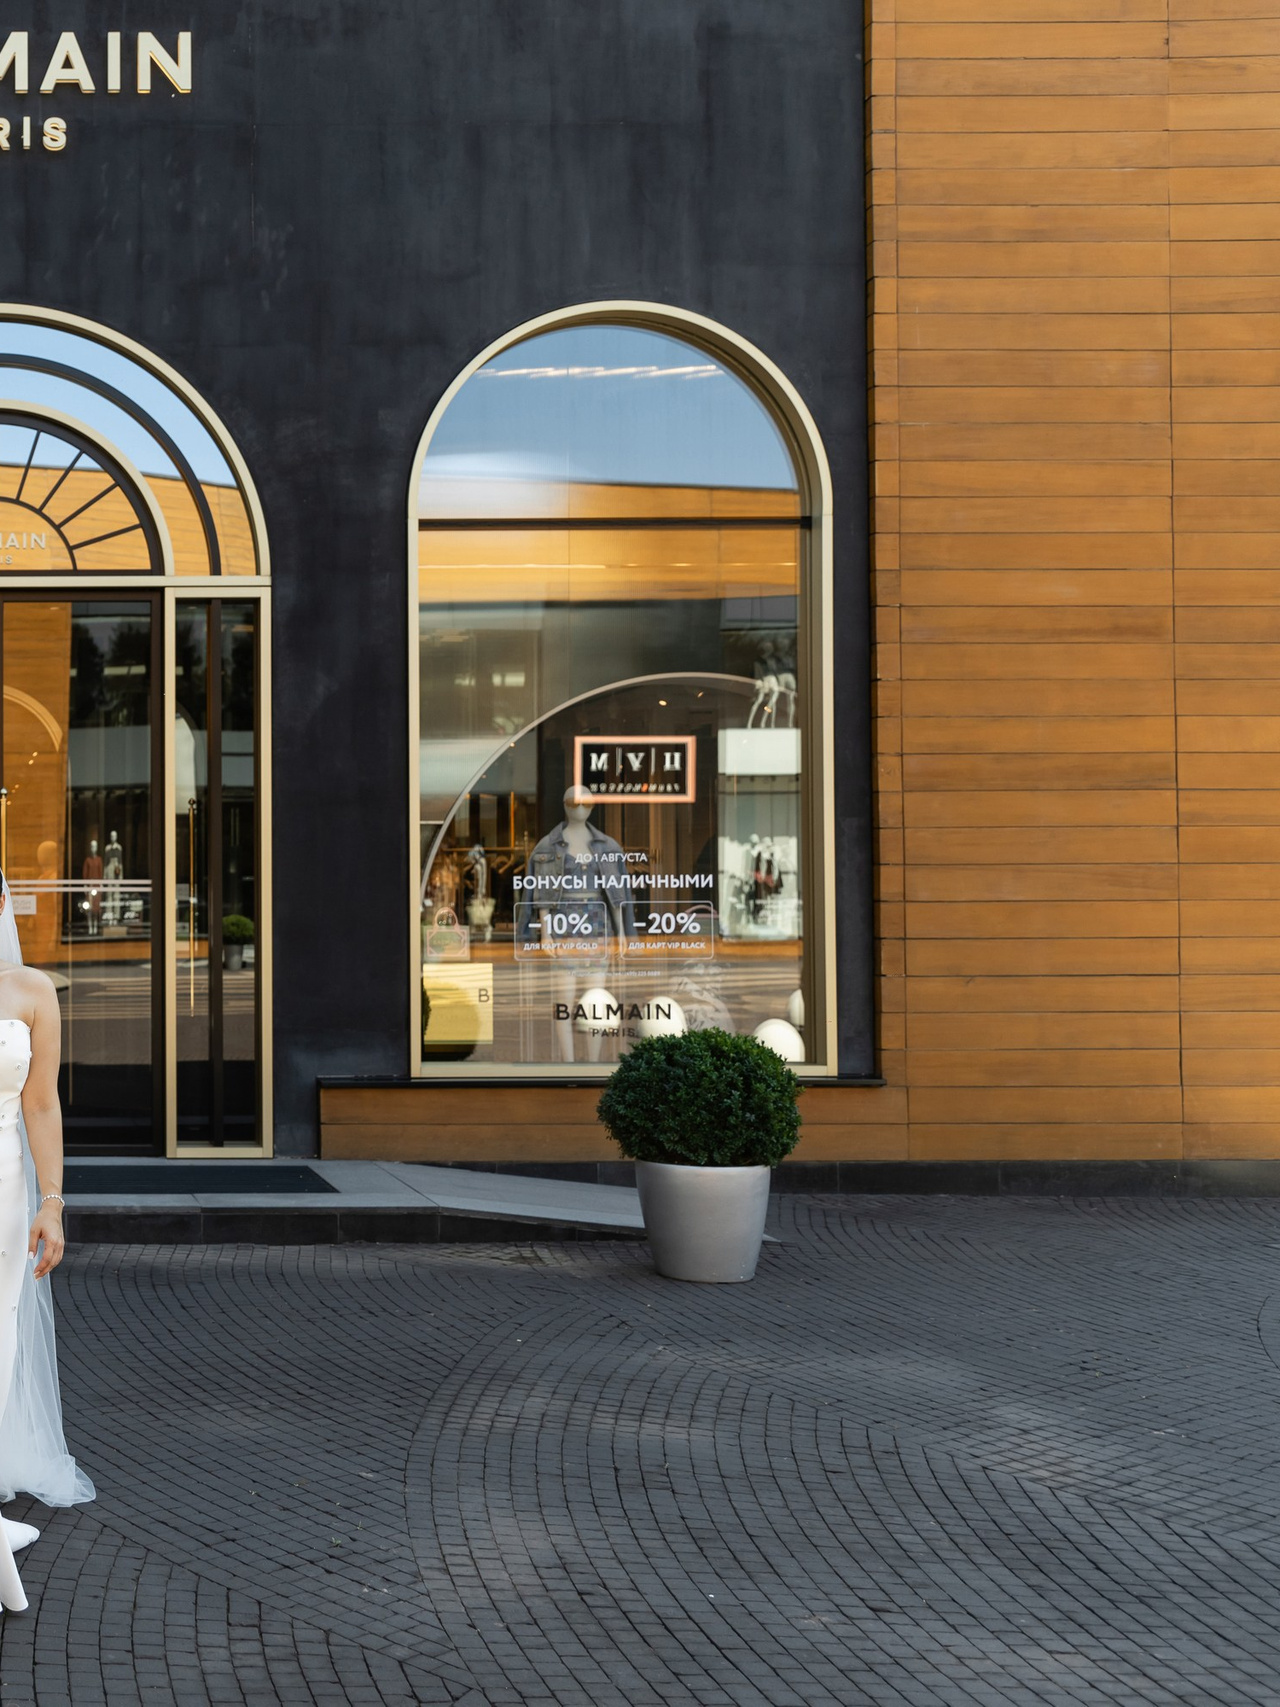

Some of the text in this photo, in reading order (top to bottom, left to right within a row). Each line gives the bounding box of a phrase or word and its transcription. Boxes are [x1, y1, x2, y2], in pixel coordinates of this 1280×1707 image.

[575, 852, 648, 864] ДО 1 АВГУСТА
[513, 874, 713, 889] БОНУСЫ НАЛИЧНЫМИ
[523, 943, 540, 951] ДЛЯ
[629, 942, 645, 950] ДЛЯ
[478, 988, 490, 1003] B
[556, 1003, 671, 1020] BALMAIN
[592, 1028, 636, 1038] PARIS
